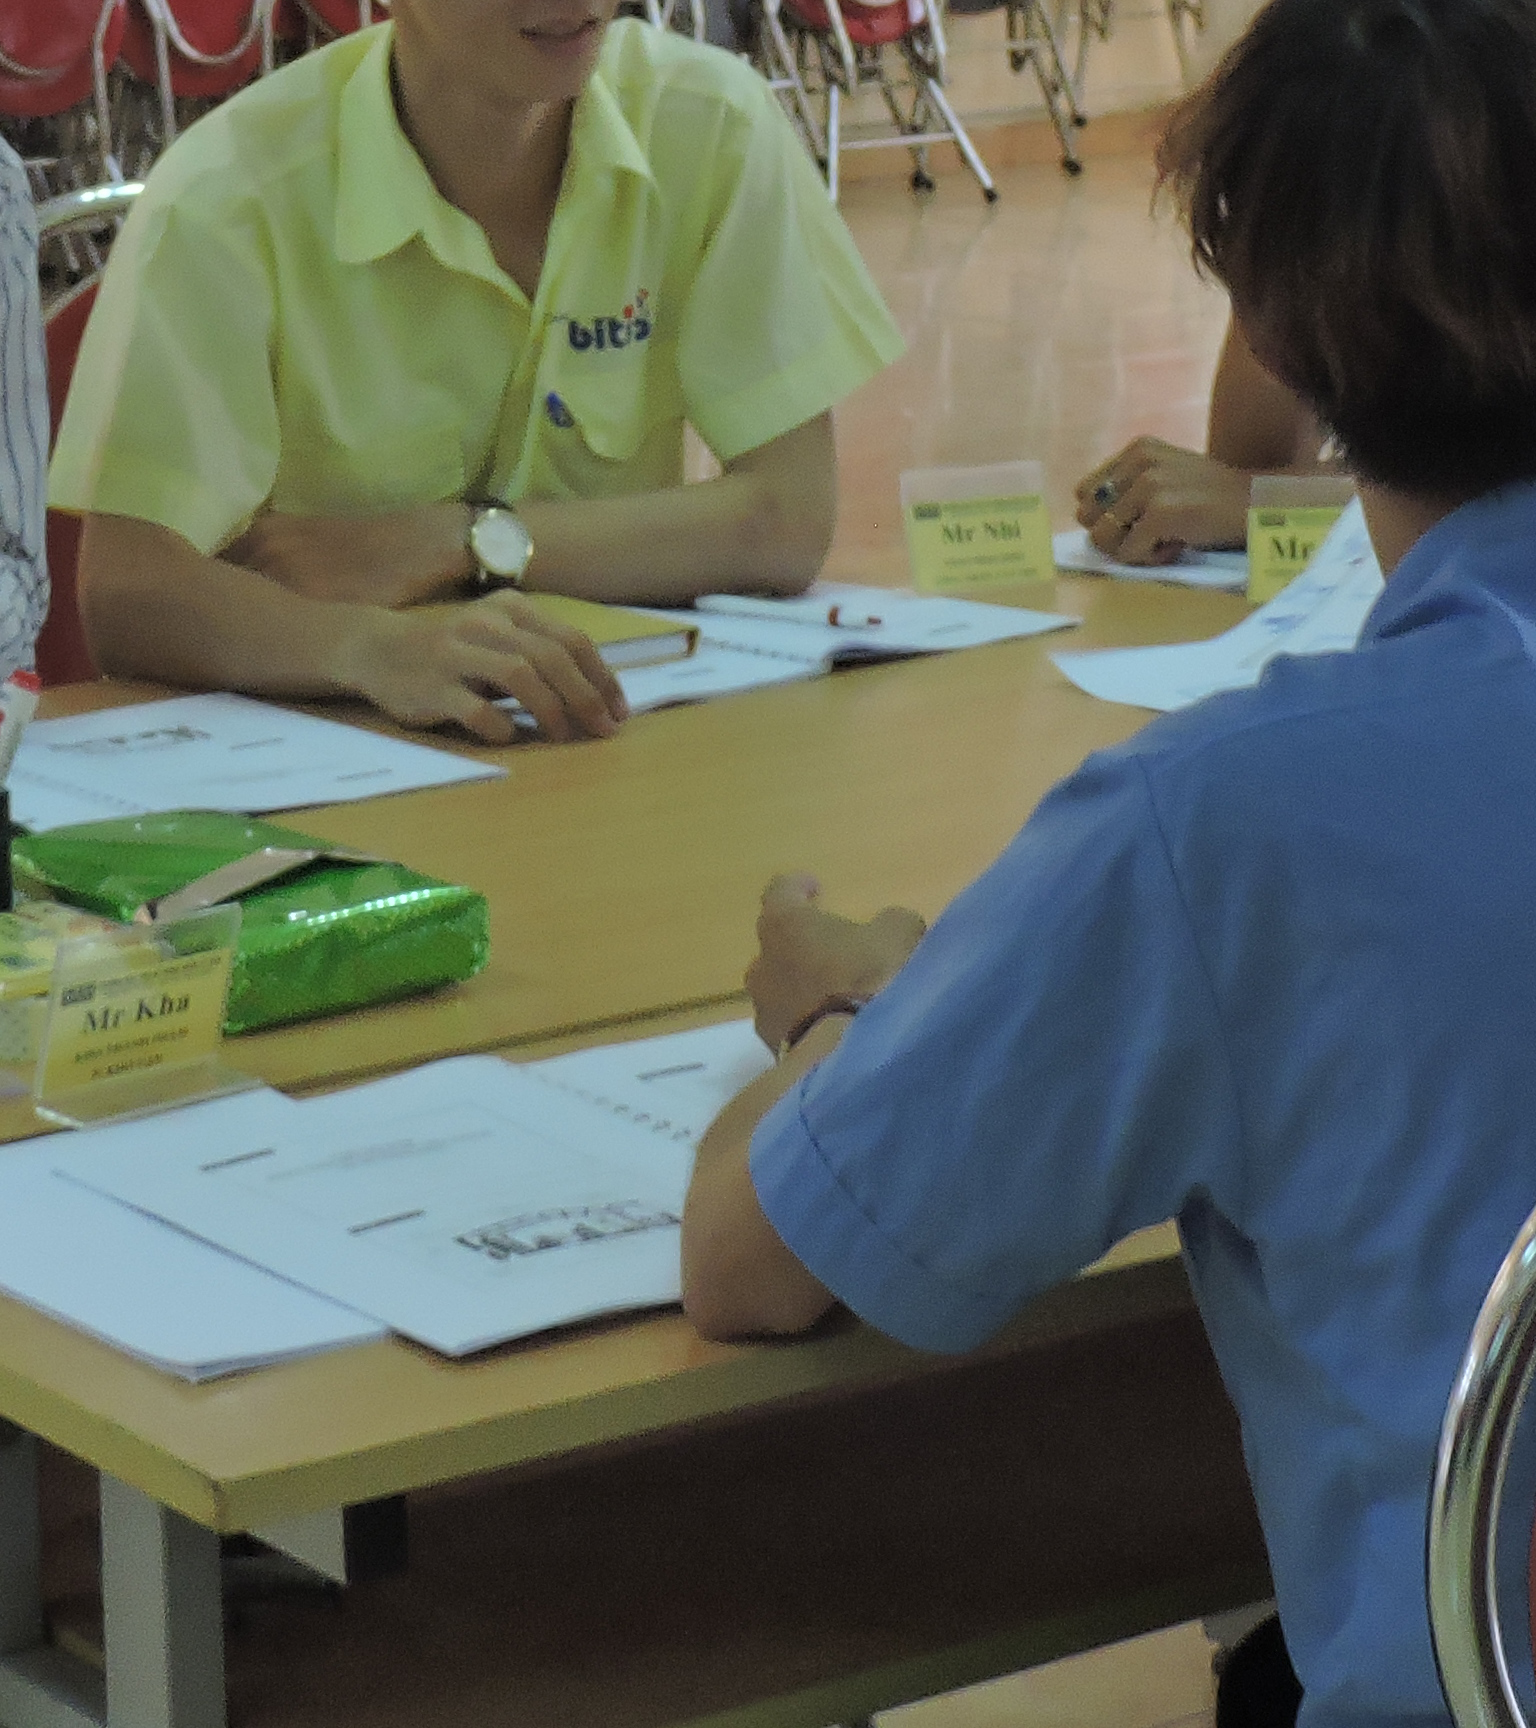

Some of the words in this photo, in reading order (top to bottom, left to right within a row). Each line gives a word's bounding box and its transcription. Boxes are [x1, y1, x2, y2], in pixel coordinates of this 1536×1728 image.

[942, 524, 974, 544] Mr
[1271, 535, 1316, 562] Mr
[82, 1006, 128, 1036] Mr
[133, 989, 192, 1026] Kha
